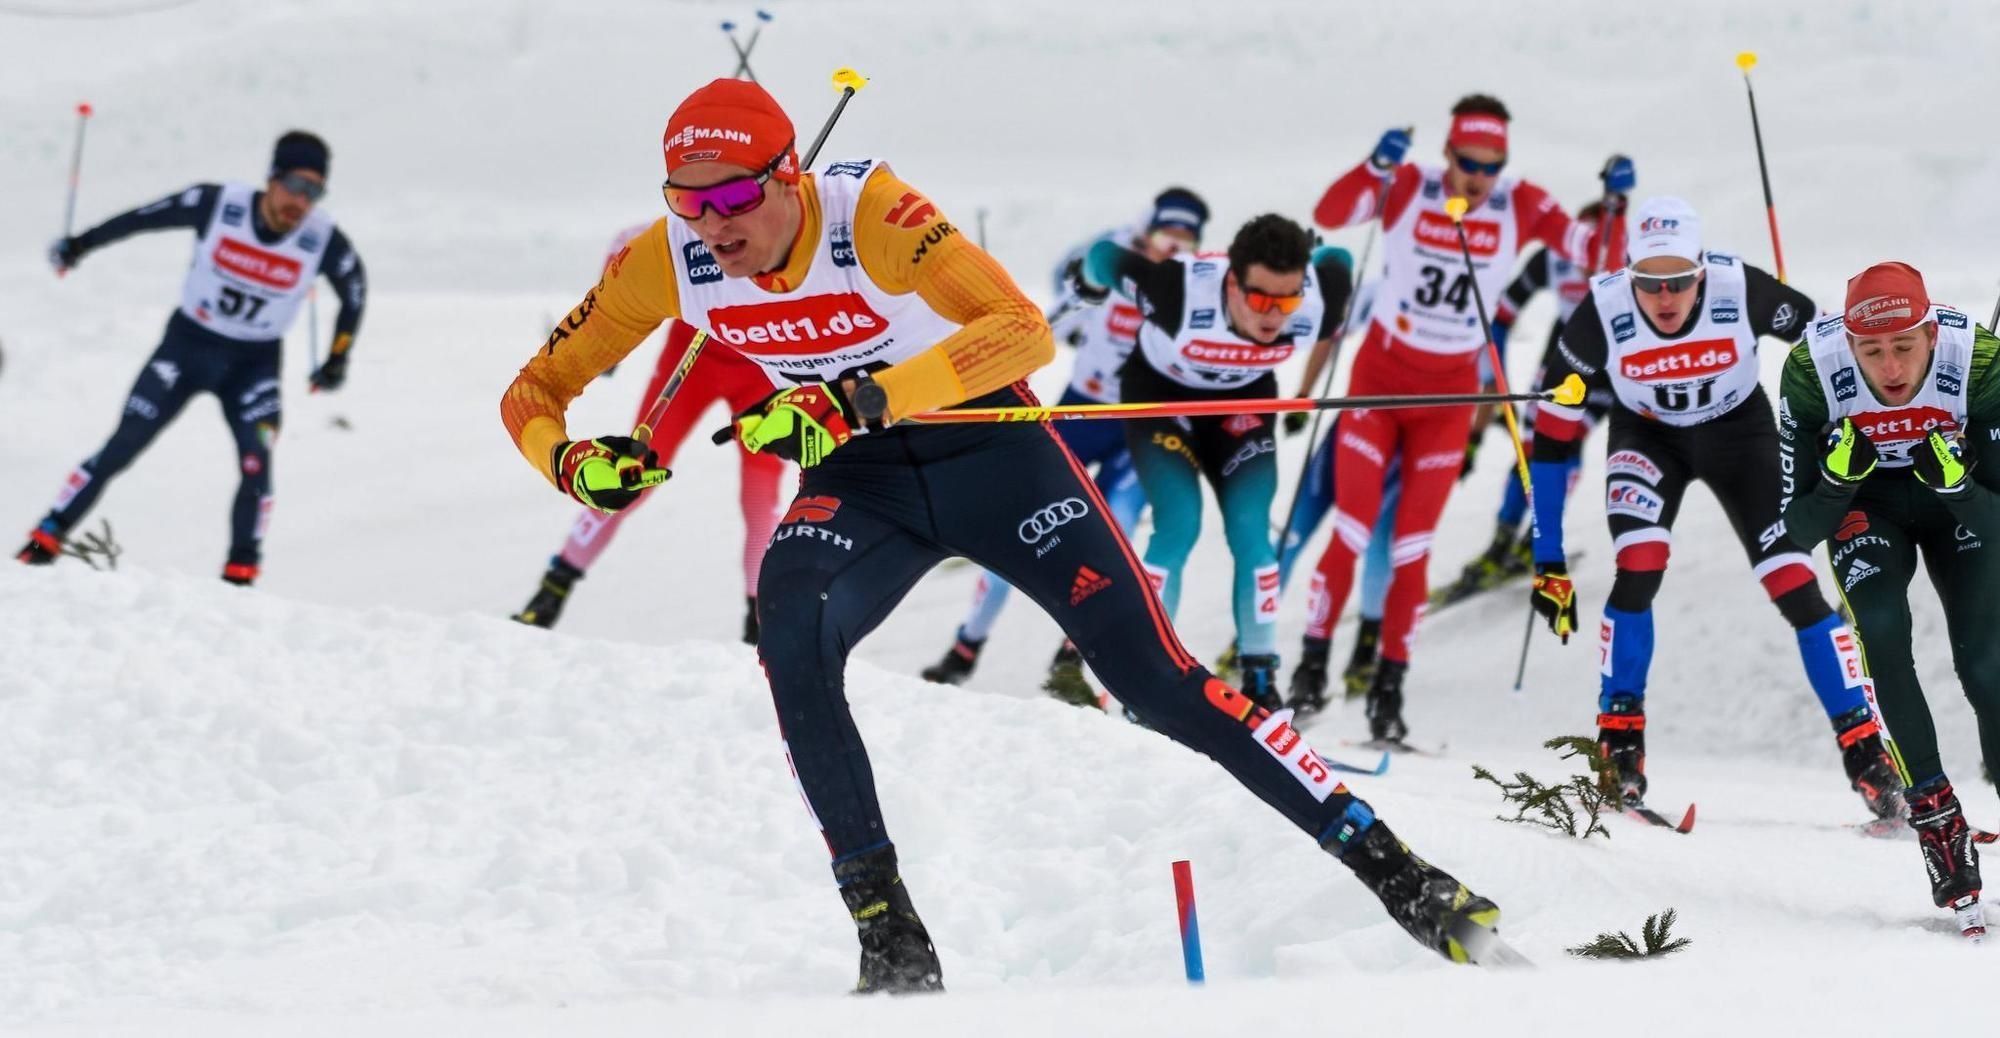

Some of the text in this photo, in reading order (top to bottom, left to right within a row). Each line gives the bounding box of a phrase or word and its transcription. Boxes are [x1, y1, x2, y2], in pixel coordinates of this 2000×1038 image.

[664, 125, 752, 152] VIESSMANN
[689, 264, 720, 278] coop
[1415, 265, 1472, 314] 34
[718, 310, 877, 346] bett1.de
[1625, 350, 1732, 378] bett1.de
[1936, 377, 1960, 391] coop
[1036, 535, 1062, 559] Audi
[1956, 541, 1982, 553] Audi
[1845, 565, 1881, 594] adidas
